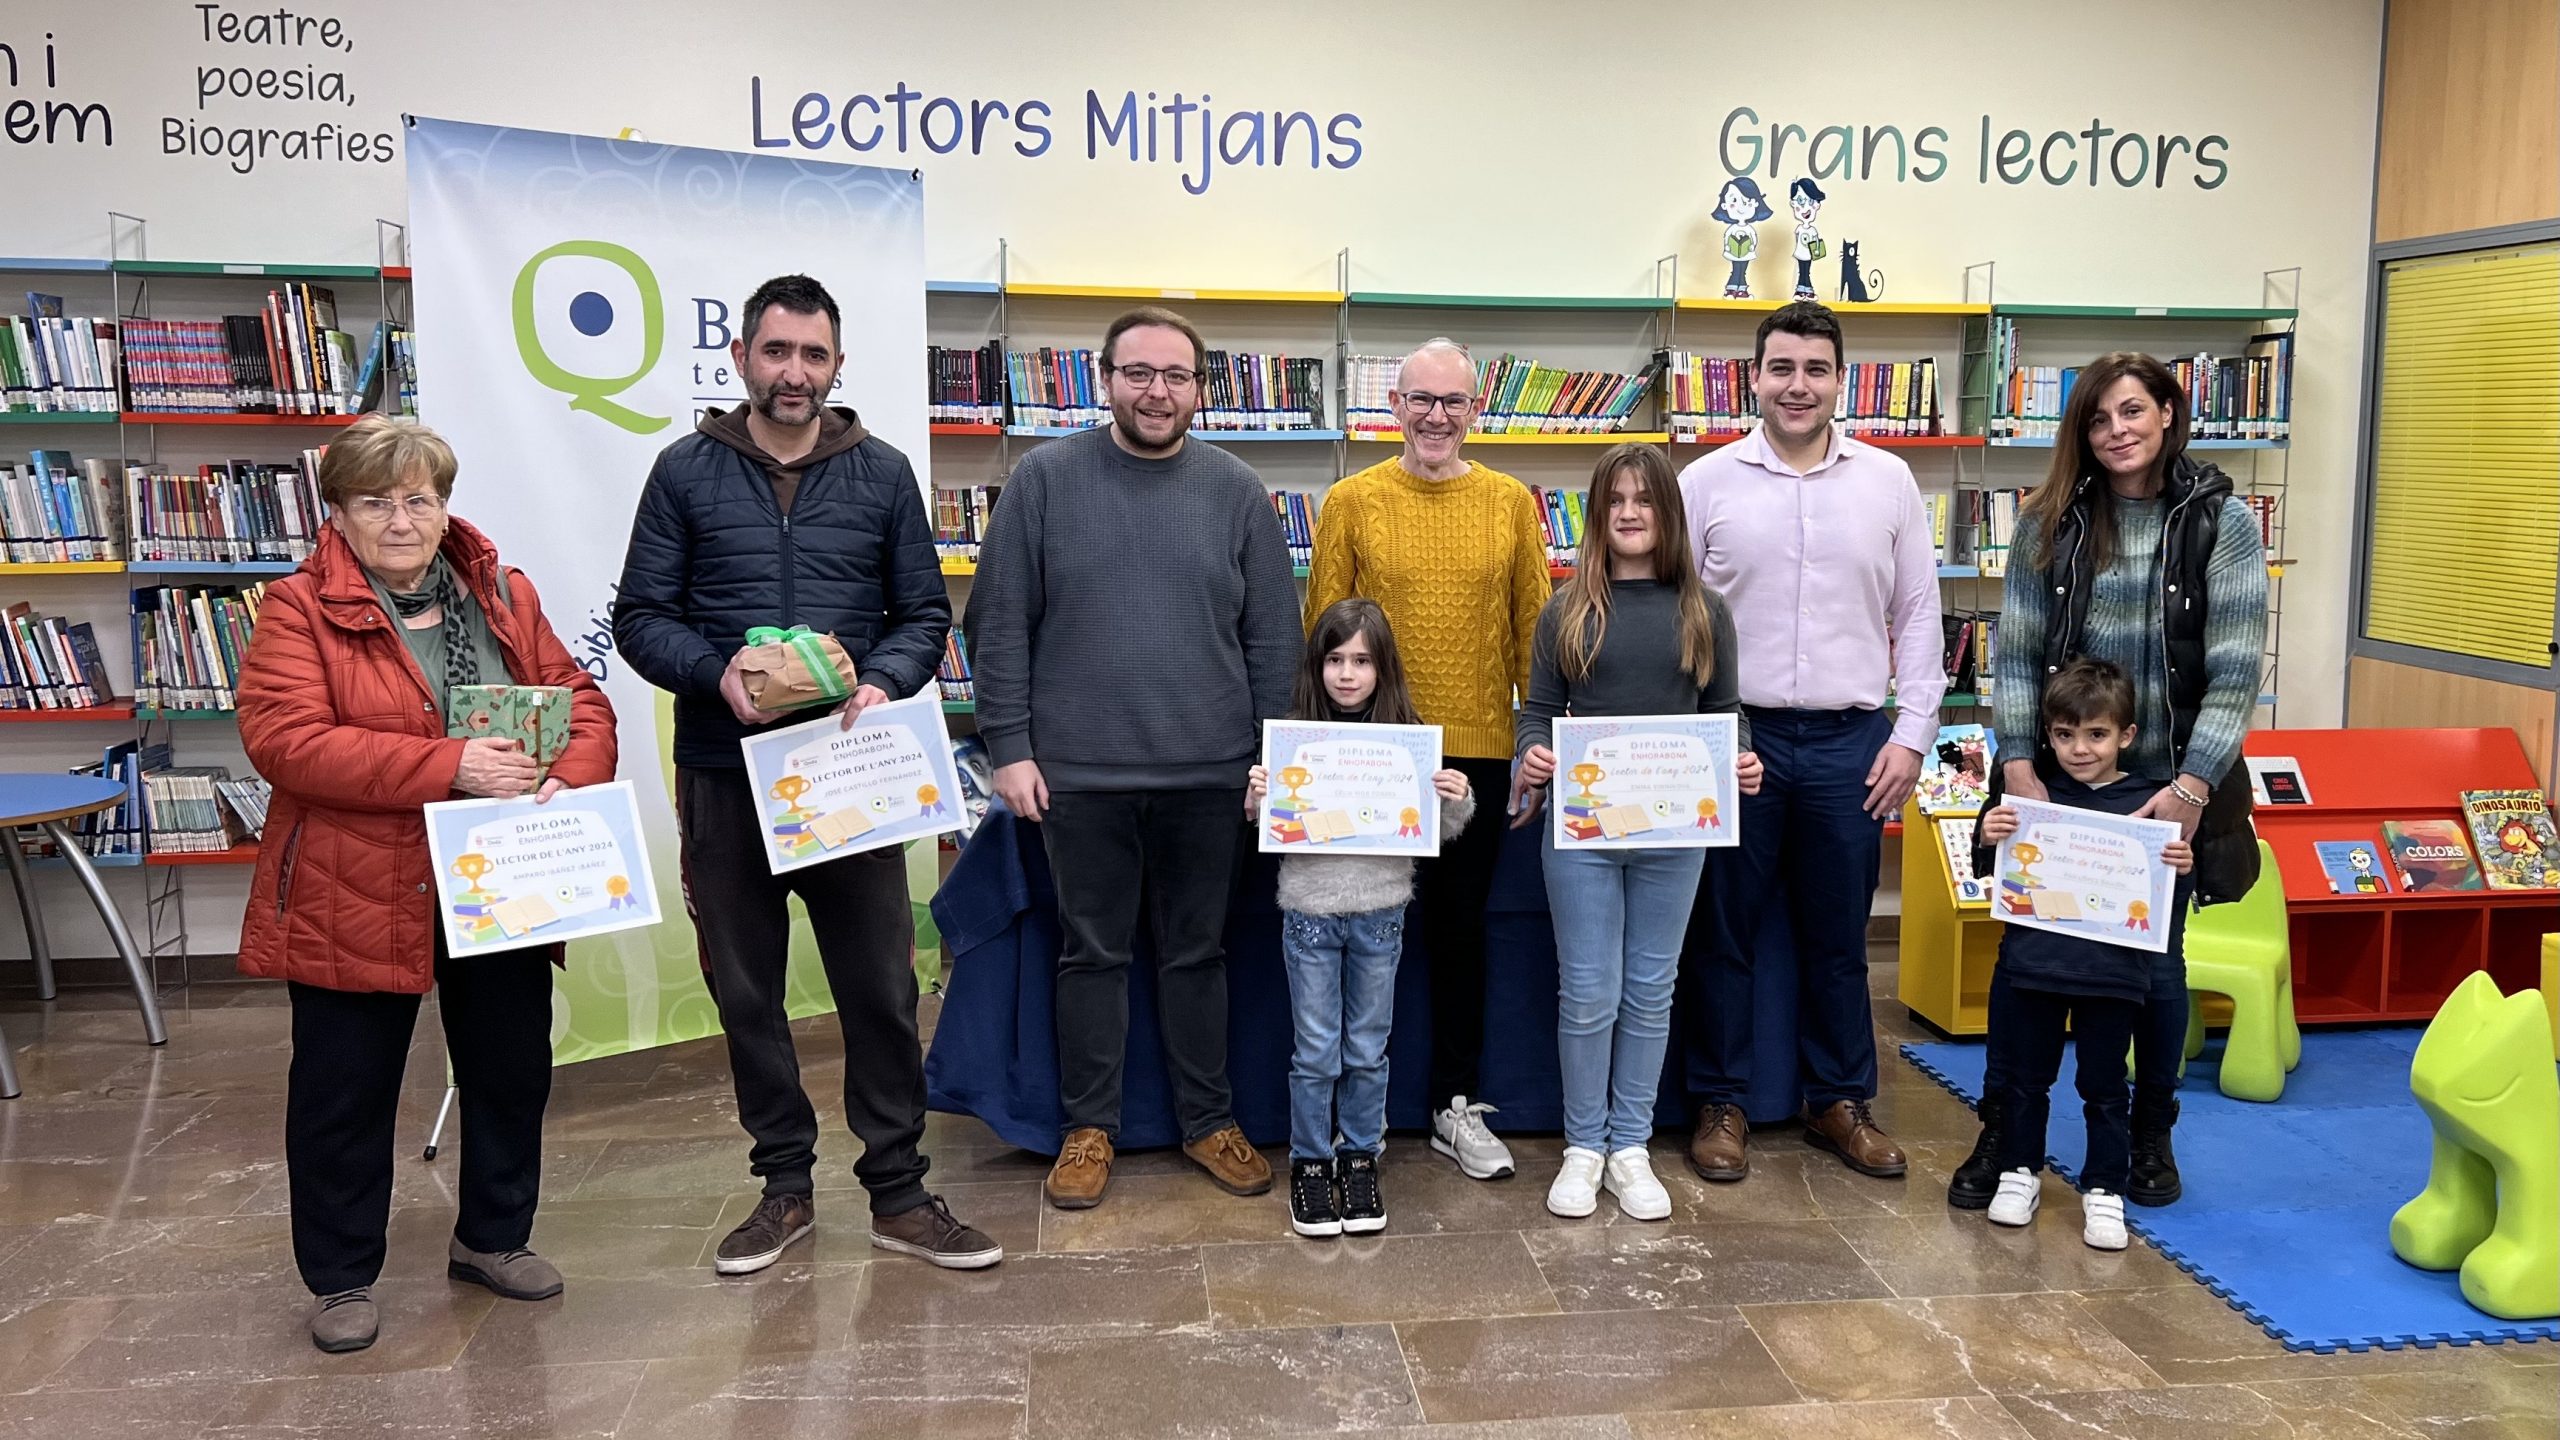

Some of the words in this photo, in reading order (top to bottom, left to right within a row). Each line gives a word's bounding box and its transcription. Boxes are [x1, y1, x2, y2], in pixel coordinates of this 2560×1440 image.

[195, 4, 354, 53] Teatre,
[197, 64, 356, 110] poesia,
[752, 75, 1053, 159] Lectors
[1086, 88, 1364, 195] Mitjans
[162, 117, 395, 174] Biografies
[1718, 106, 1949, 183] Grans
[1979, 114, 2230, 191] lectors
[830, 730, 893, 751] DIPLOMA
[1630, 741, 1687, 750] DIPLOMA
[833, 742, 895, 762] ENHORABONA
[1338, 747, 1393, 757] DIPLOMA
[1631, 752, 1688, 760] ENHORABONA
[812, 768, 852, 784] LECTOR
[854, 763, 867, 773] DE
[869, 757, 897, 770] L'ANY
[899, 752, 923, 764] 2024
[1682, 765, 1709, 775] 2024
[1387, 773, 1413, 783] 2024
[2471, 799, 2542, 814] DINOSAURIO
[515, 816, 581, 834] DIPLOMA
[518, 828, 585, 846] ENHORABONA
[2069, 831, 2126, 848] DIPLOMA
[495, 852, 537, 866] LECTOR
[539, 849, 554, 860] DE
[556, 845, 586, 858] L'ANY
[589, 840, 613, 852] 2024
[2405, 846, 2464, 859] COLORS
[2117, 862, 2145, 876] 2024
